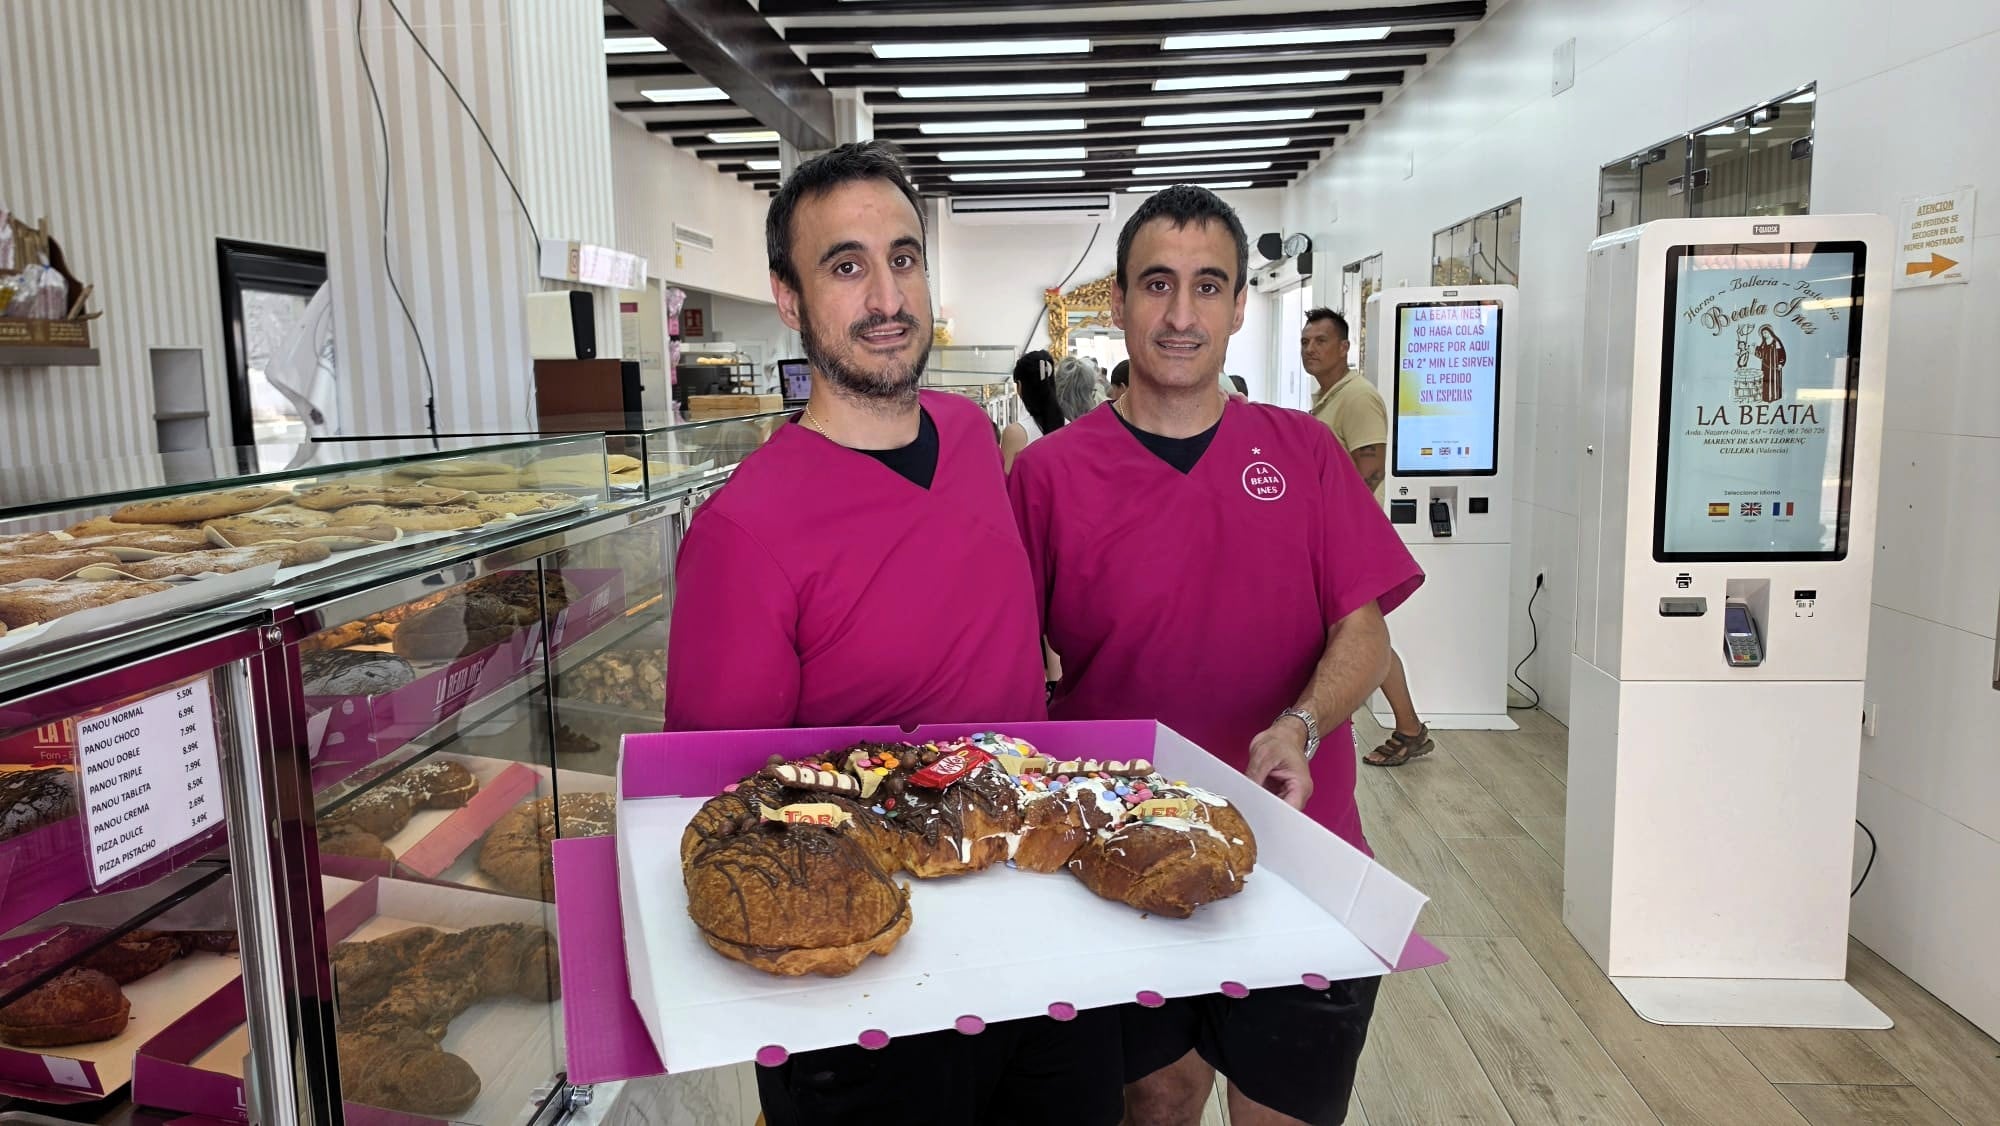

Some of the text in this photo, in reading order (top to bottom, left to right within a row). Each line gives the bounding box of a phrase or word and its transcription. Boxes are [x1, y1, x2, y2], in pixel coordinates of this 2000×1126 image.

[1917, 200, 1954, 216] ATENCION
[1912, 214, 1959, 230] LOS PEDIDOS SE
[1940, 227, 1949, 236] EN
[1950, 226, 1957, 234] EL
[1925, 236, 1965, 248] MOSTRADOR
[1415, 308, 1481, 321] LA BEATA INES
[1683, 295, 1715, 324] Horno
[1701, 298, 1768, 336] Beata
[1414, 325, 1485, 337] NO HAGA COLAS
[1408, 341, 1490, 353] COMPRE POR AQUI
[1403, 358, 1414, 369] EN
[1429, 358, 1445, 368] MIN
[1448, 357, 1459, 367] LE
[1462, 356, 1494, 367] SIRVEN
[1427, 373, 1472, 384] EL PEDIDO
[1421, 389, 1472, 402] SIN ESPERAS
[1696, 404, 1819, 426] LA BEATA
[1256, 467, 1268, 475] LA
[1250, 476, 1279, 485] BEATA
[1257, 487, 1278, 495] INES
[82, 721, 110, 736] PANOU
[112, 706, 144, 729] NORMAL
[176, 687, 193, 700] 5.50€
[37, 721, 59, 743] LA
[84, 739, 113, 755] PANOU
[114, 727, 141, 744] CHOCO
[178, 705, 195, 719] 6.99€
[87, 723, 197, 776] PANOU DOBLE 7.99€
[89, 741, 199, 795] PANOU TRIPLE 8.99€
[91, 759, 201, 815] PANOU TABLETA 7.99€
[94, 776, 204, 835] PANOU CREMA 8.50€
[96, 838, 119, 854] PIZZA
[120, 826, 144, 843] DULCE
[99, 812, 208, 874] PIZZA PISTACHO 3.49€
